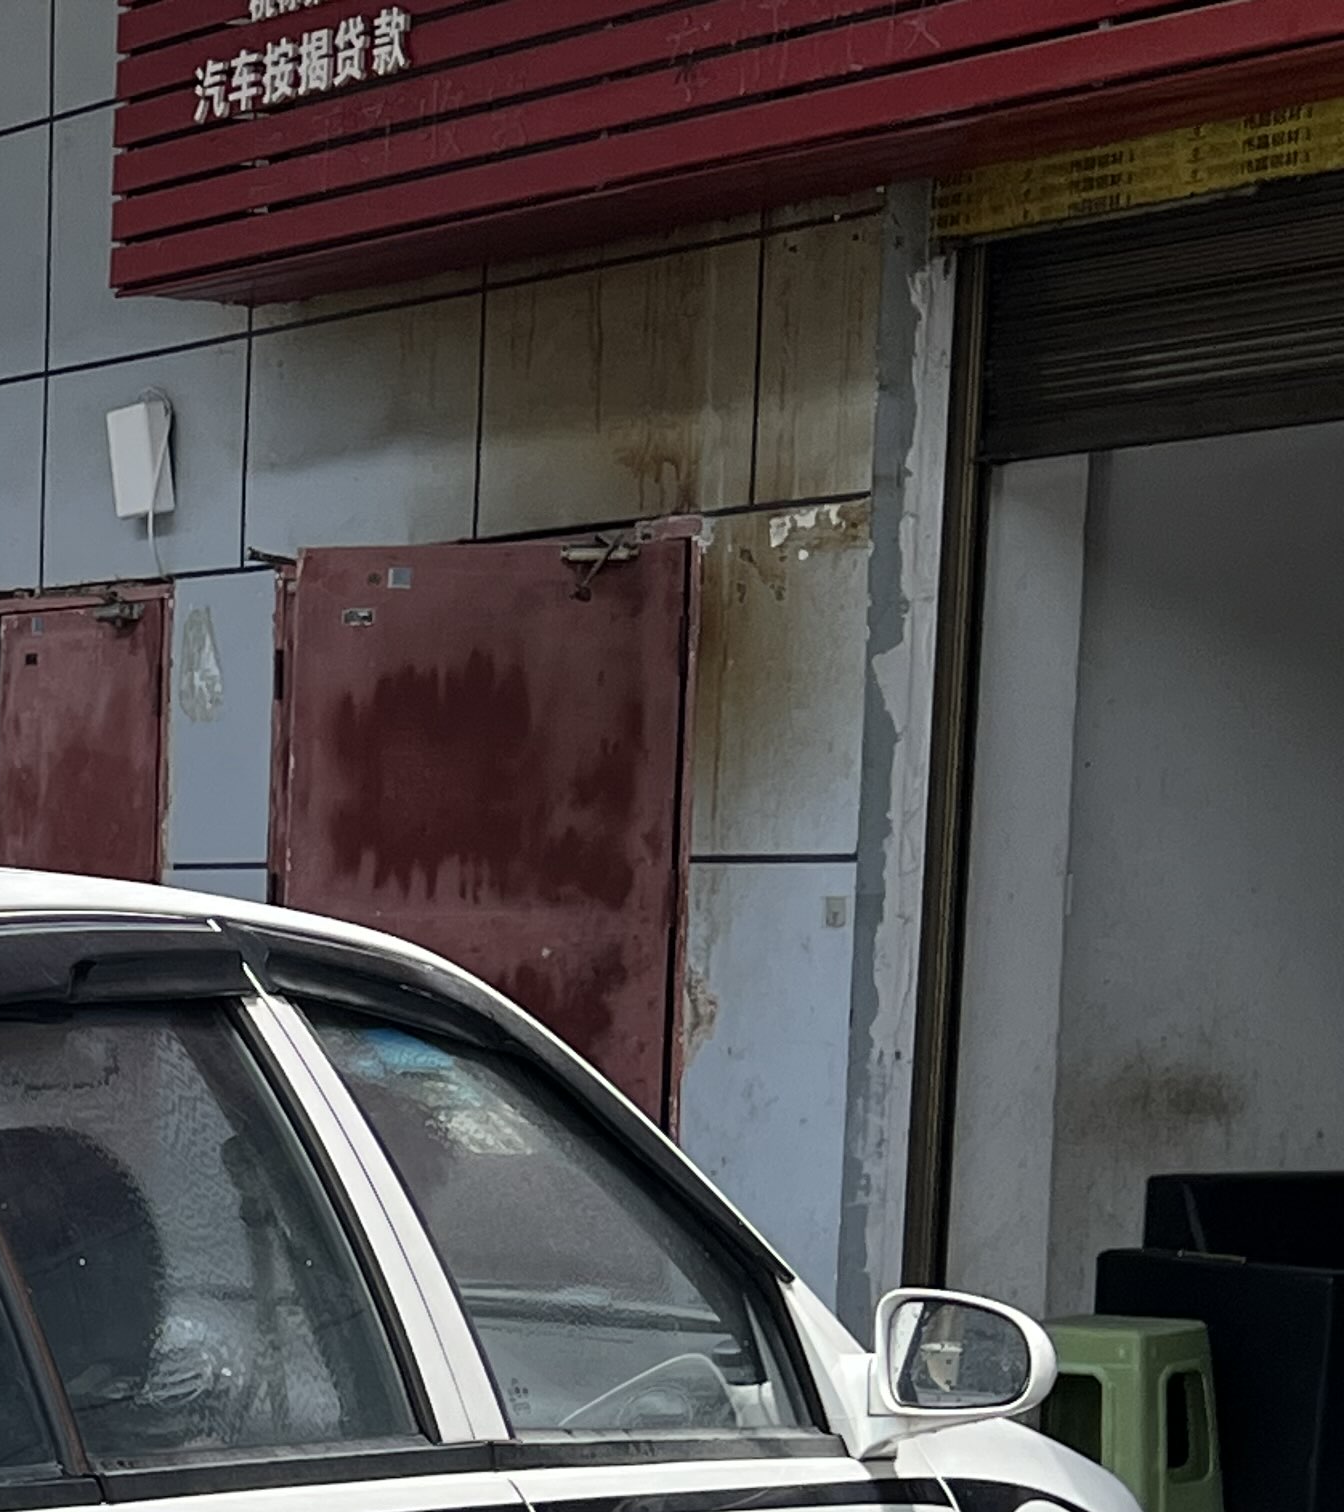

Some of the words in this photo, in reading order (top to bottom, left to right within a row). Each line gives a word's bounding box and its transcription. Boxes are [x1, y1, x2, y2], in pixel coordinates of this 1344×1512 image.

[193, 8, 412, 123] 汽车按揭贷款
